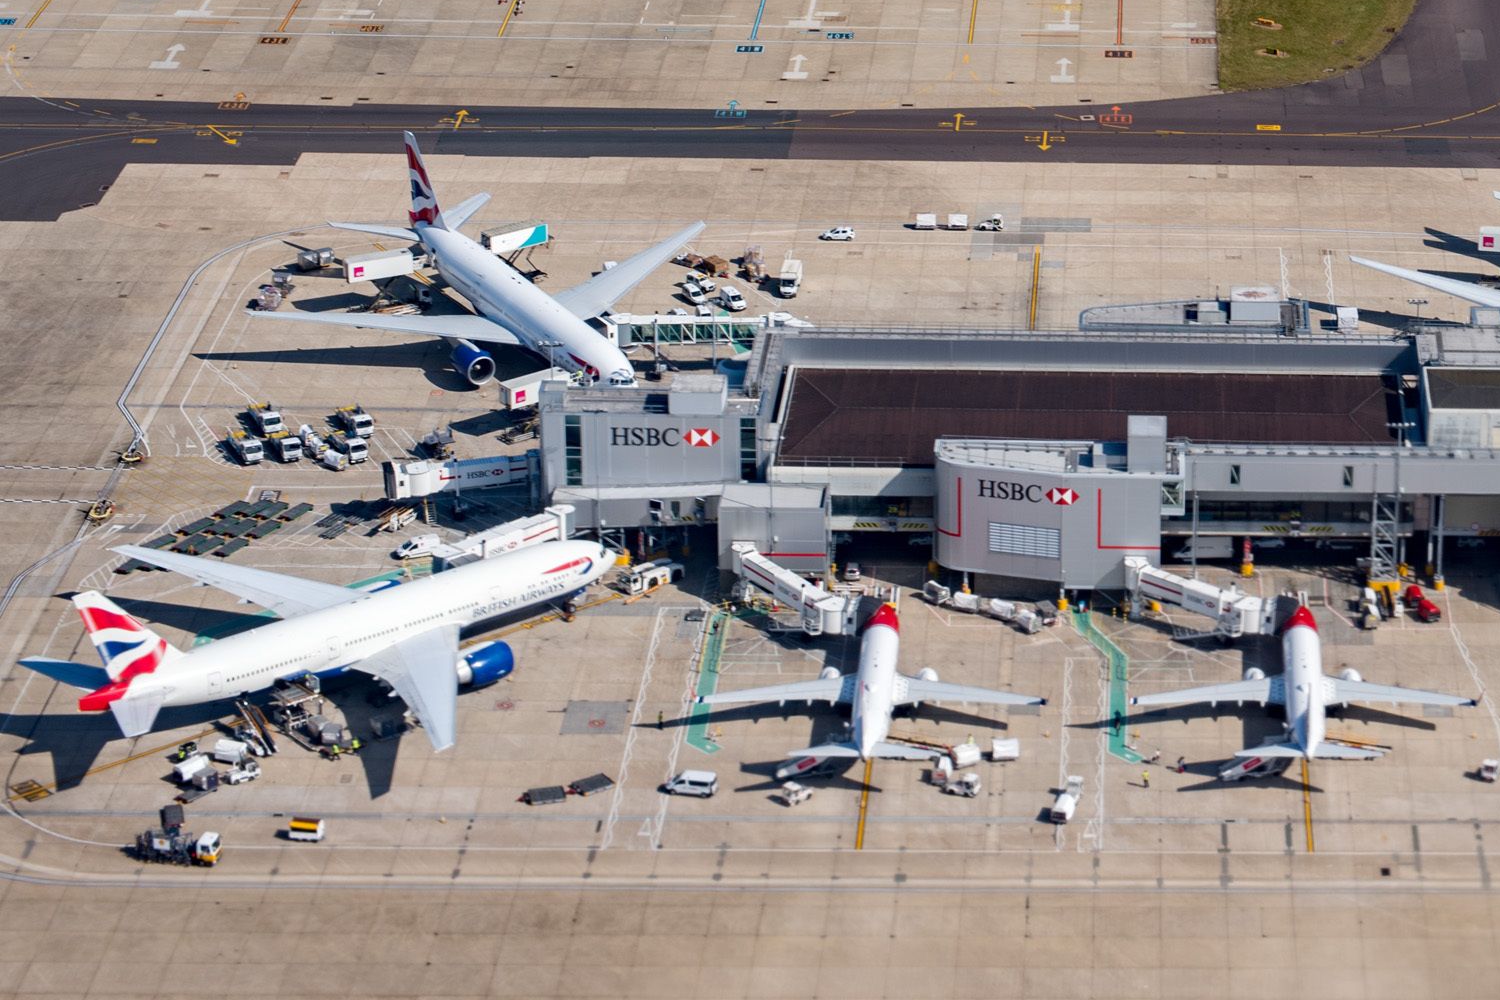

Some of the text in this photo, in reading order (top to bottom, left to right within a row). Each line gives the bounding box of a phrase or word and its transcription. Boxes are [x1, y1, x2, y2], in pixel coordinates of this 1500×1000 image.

[611, 427, 680, 447] HSBC
[467, 470, 490, 480] HSBC
[978, 478, 1042, 504] HSBC
[472, 582, 566, 618] BRITISH AIRWAYS
